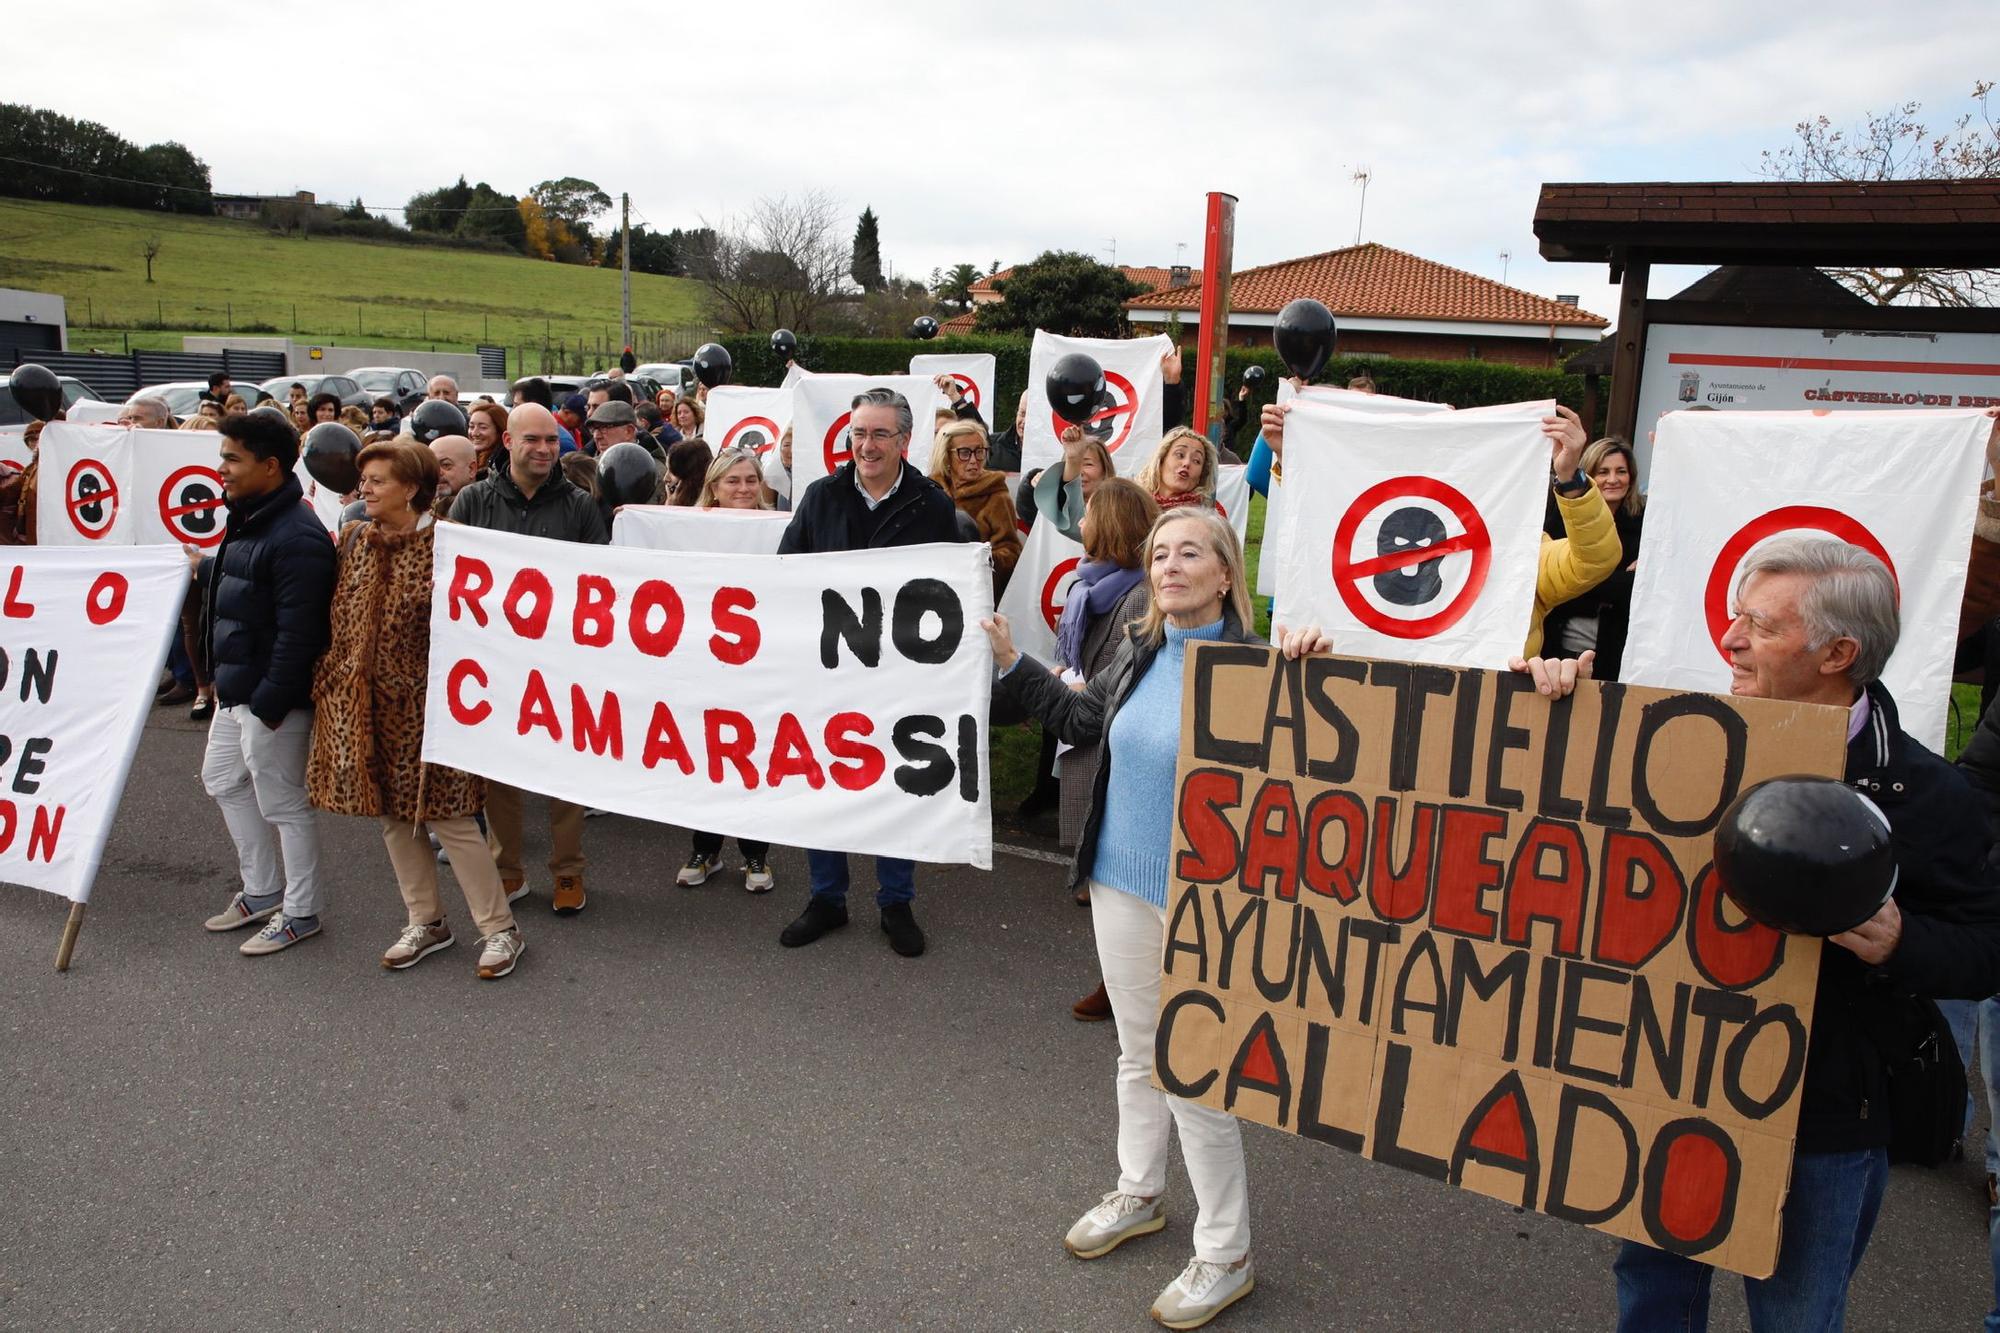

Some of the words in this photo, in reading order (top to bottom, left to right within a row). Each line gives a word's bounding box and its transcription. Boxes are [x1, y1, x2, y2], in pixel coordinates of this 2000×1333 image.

[1707, 391, 1734, 404] Gijón
[1708, 382, 1756, 391] Ayuntamiento
[1923, 394, 1952, 406] DE
[448, 554, 761, 665] ROBOS
[821, 578, 965, 669] NO
[1194, 645, 1748, 836] CASTIELLO
[1163, 884, 1808, 1121] AYUNTAMIENTO
[1154, 988, 1741, 1257] CALLADO
